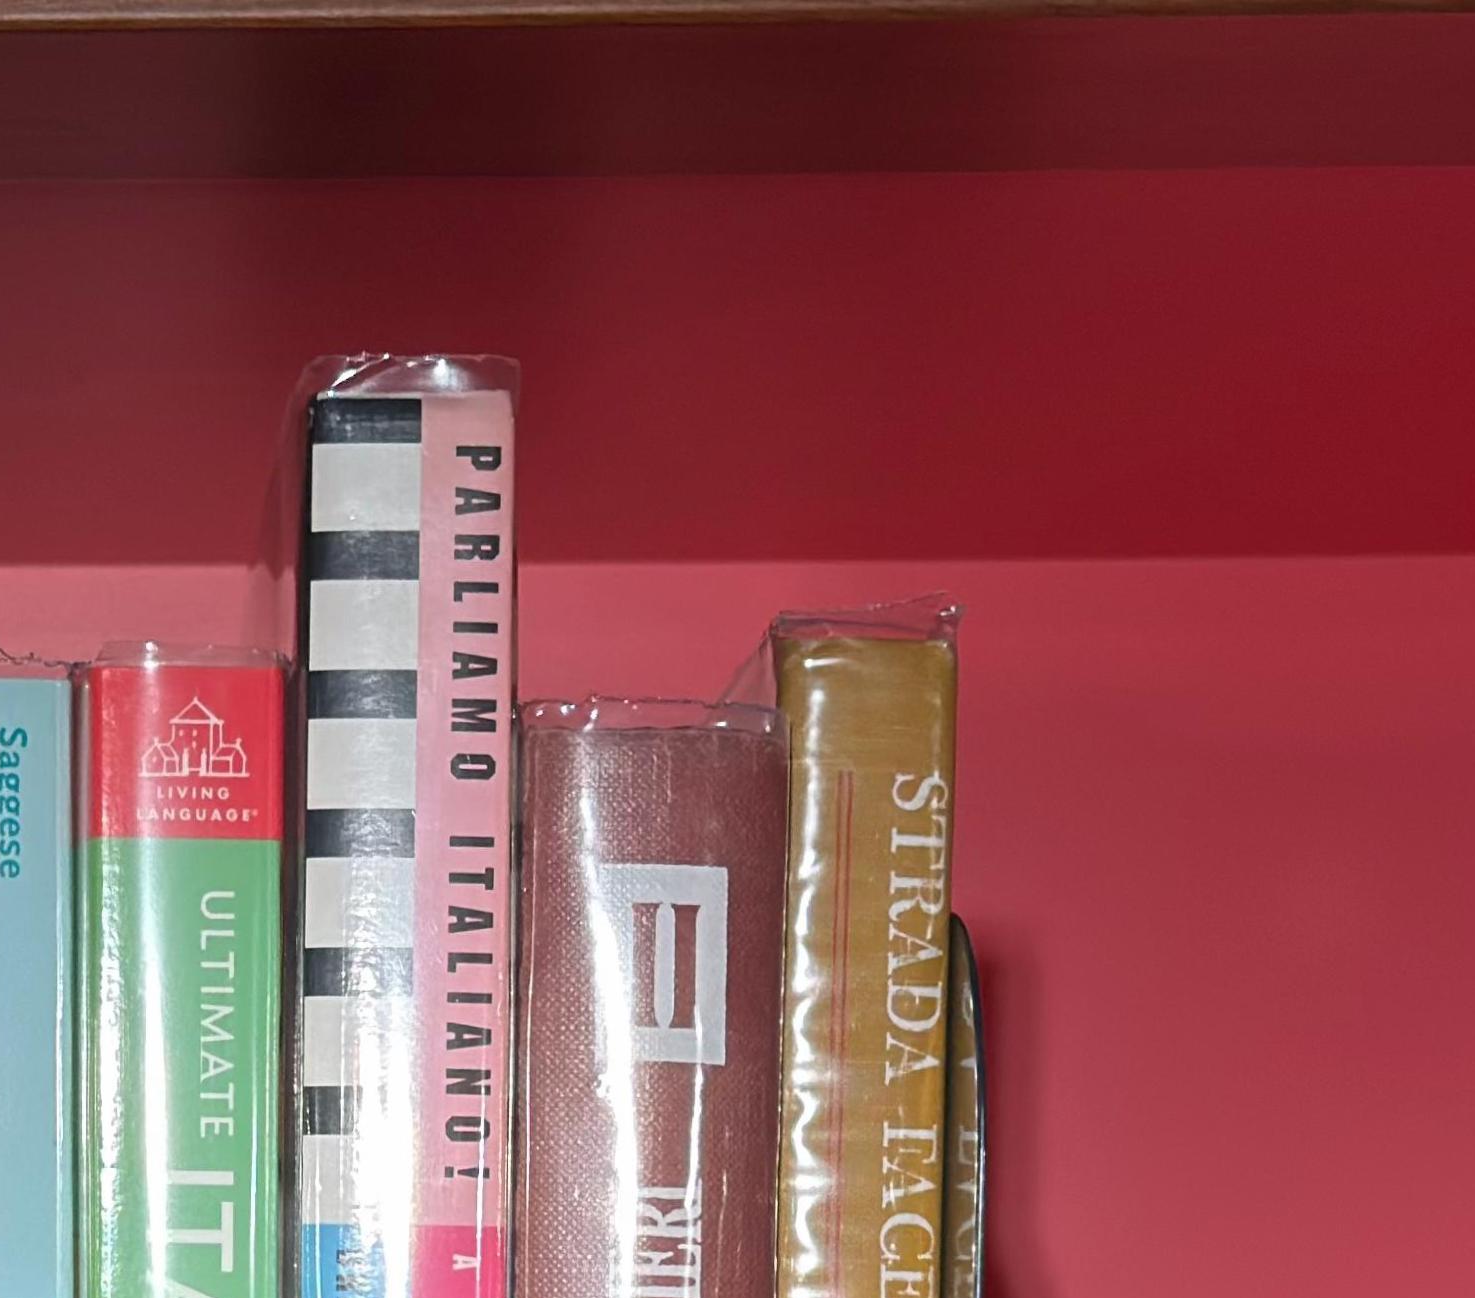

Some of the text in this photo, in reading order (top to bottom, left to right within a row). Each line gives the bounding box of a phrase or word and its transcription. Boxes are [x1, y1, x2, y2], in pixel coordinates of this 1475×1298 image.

[157, 785, 230, 800] LIVING
[444, 445, 502, 1178] PARLIAMO ITALIANO!
[200, 890, 236, 1138] ULTIMATE
[884, 770, 949, 1088] STRADA
[452, 1253, 479, 1271] A
